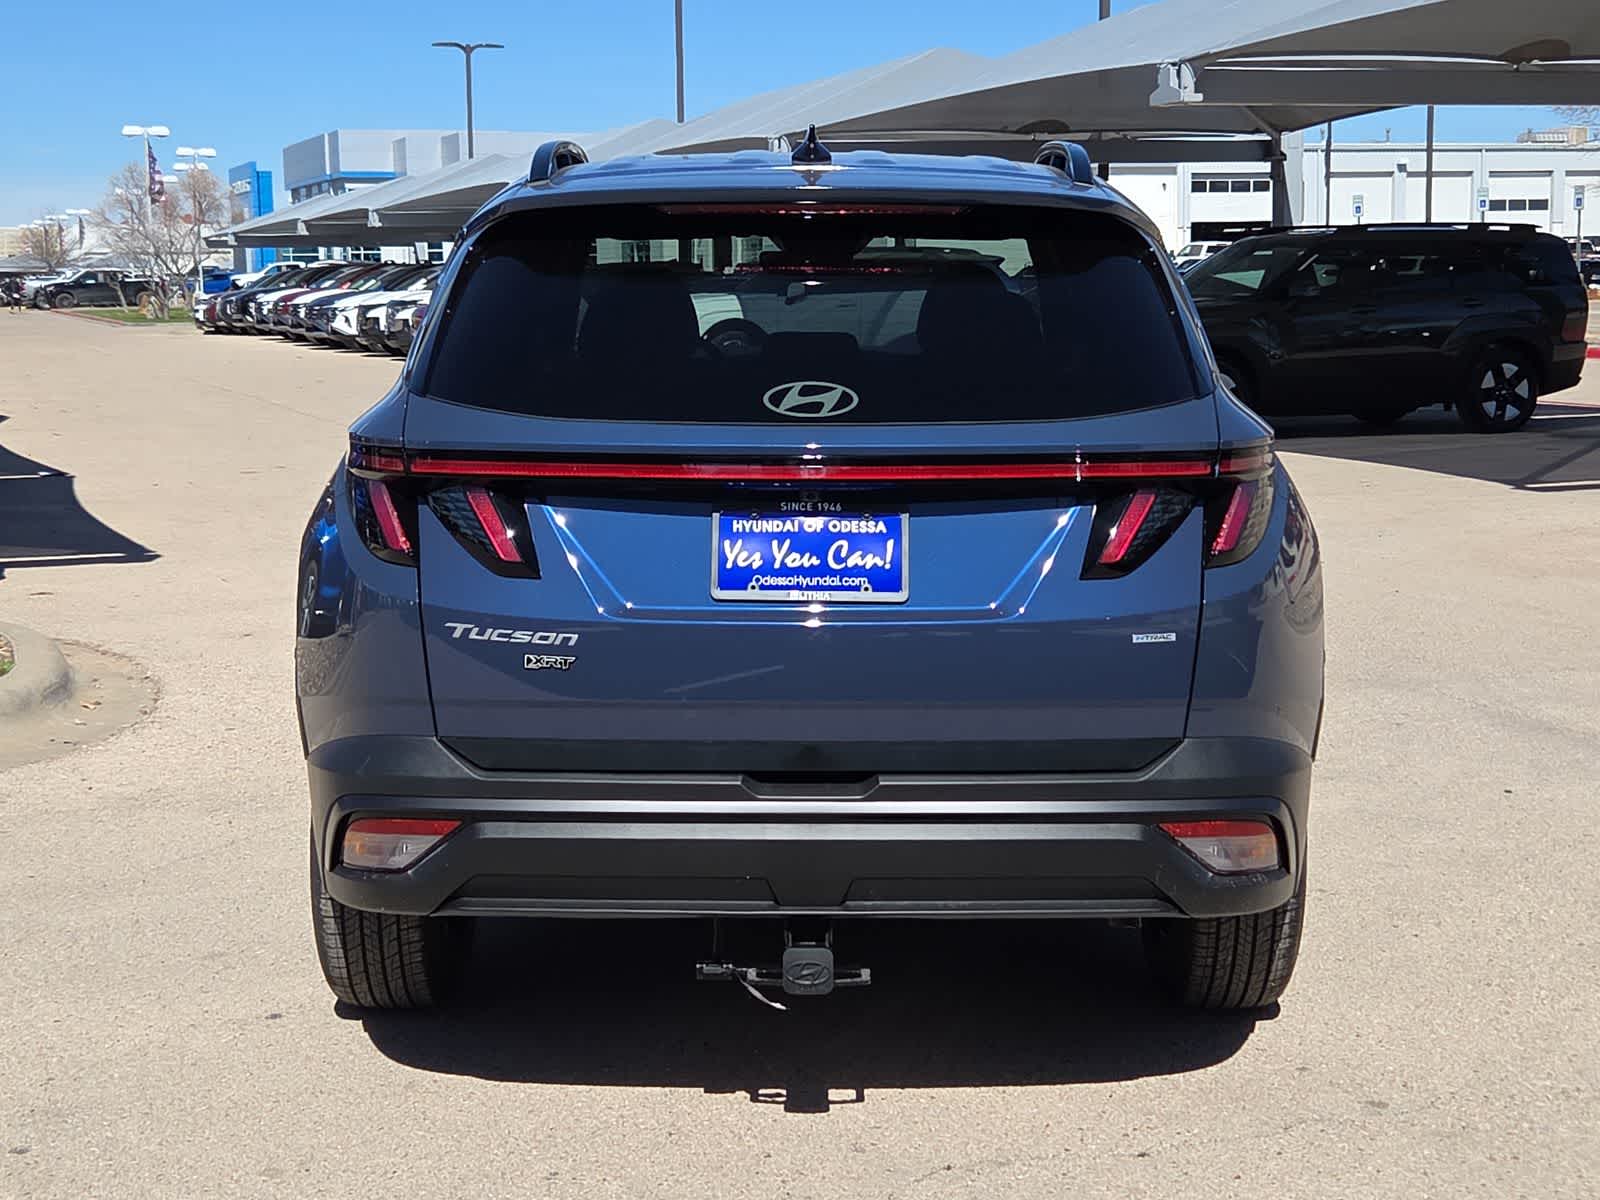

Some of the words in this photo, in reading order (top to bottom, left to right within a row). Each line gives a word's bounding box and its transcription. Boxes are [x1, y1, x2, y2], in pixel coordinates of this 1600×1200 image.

[780, 502, 813, 512] SINCE
[817, 502, 842, 512] 1946
[732, 520, 799, 533] HYUNDAI
[803, 520, 825, 533] OF
[828, 520, 887, 533] ODESSA
[723, 539, 763, 569] Yes
[771, 539, 820, 569] You
[827, 539, 894, 569] Can!
[752, 575, 868, 587] OdessaHyundai.com
